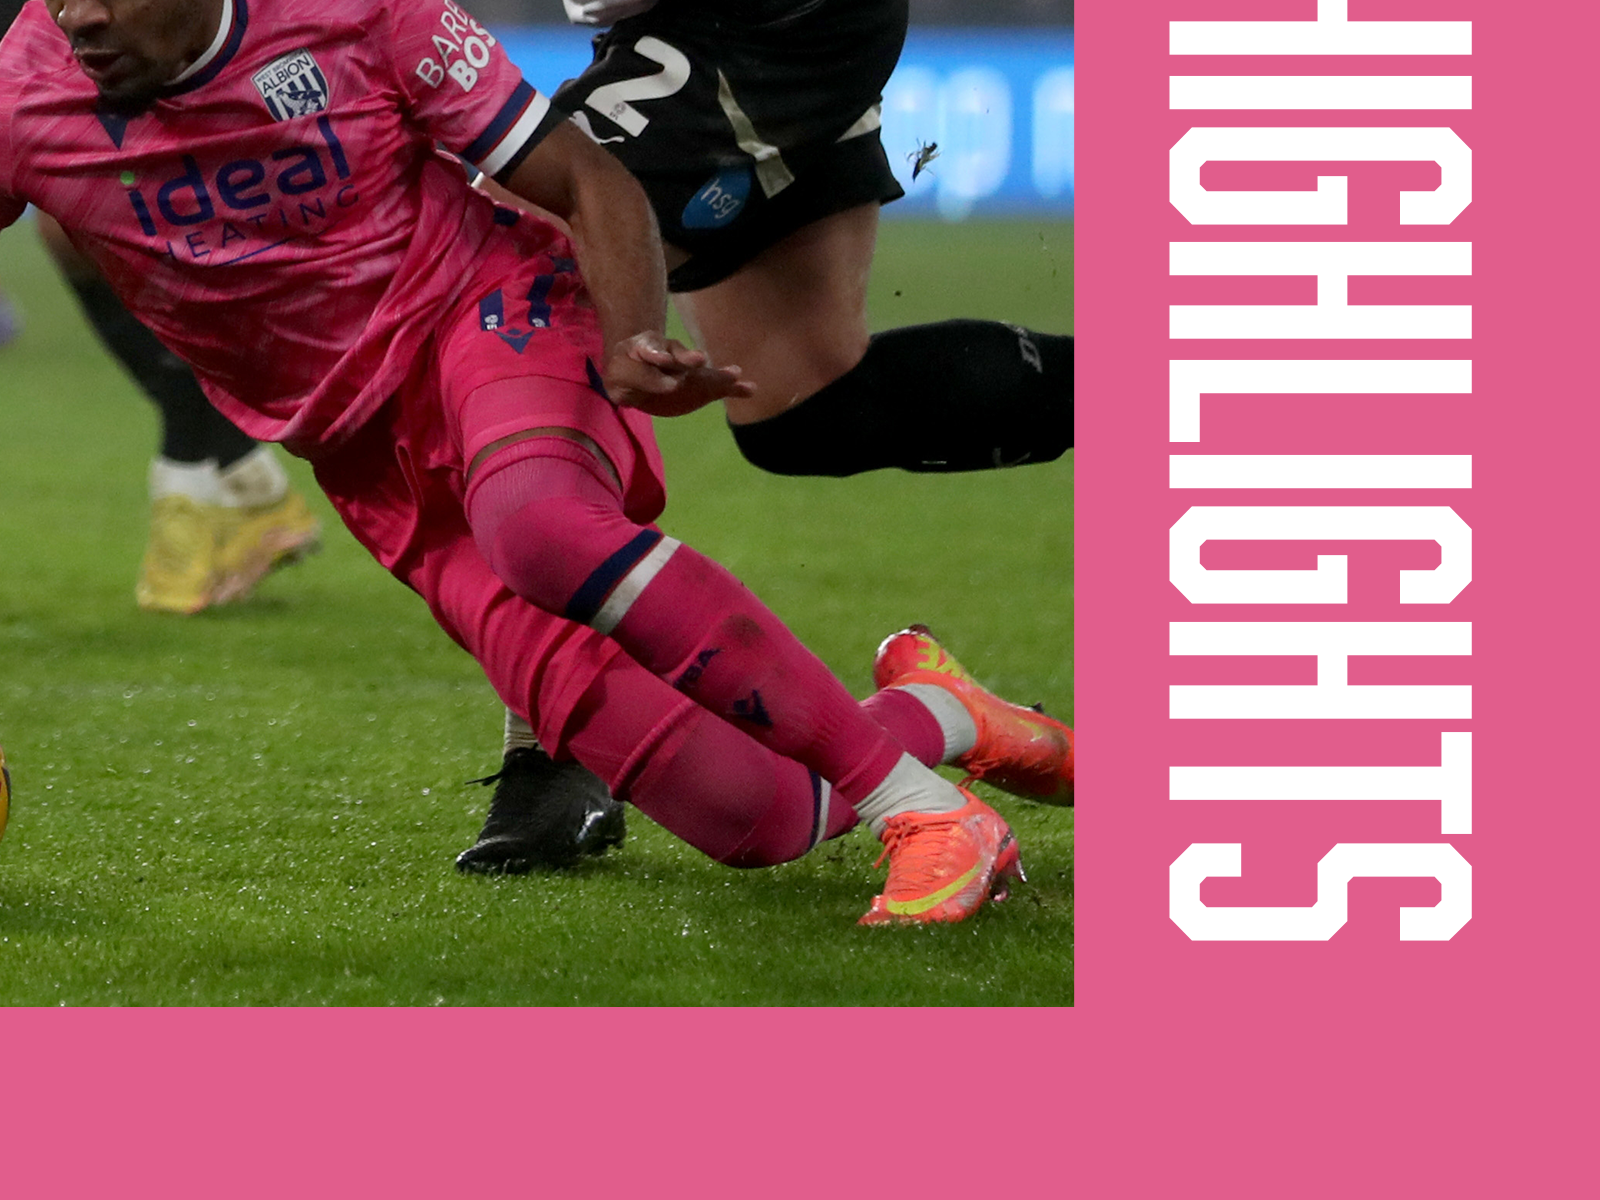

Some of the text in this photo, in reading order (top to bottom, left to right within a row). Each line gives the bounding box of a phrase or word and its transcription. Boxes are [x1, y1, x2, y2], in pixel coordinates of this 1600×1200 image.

[262, 54, 311, 94] ALBION
[584, 35, 691, 138] 2
[120, 115, 350, 237] ideal
[700, 178, 740, 219] hsg
